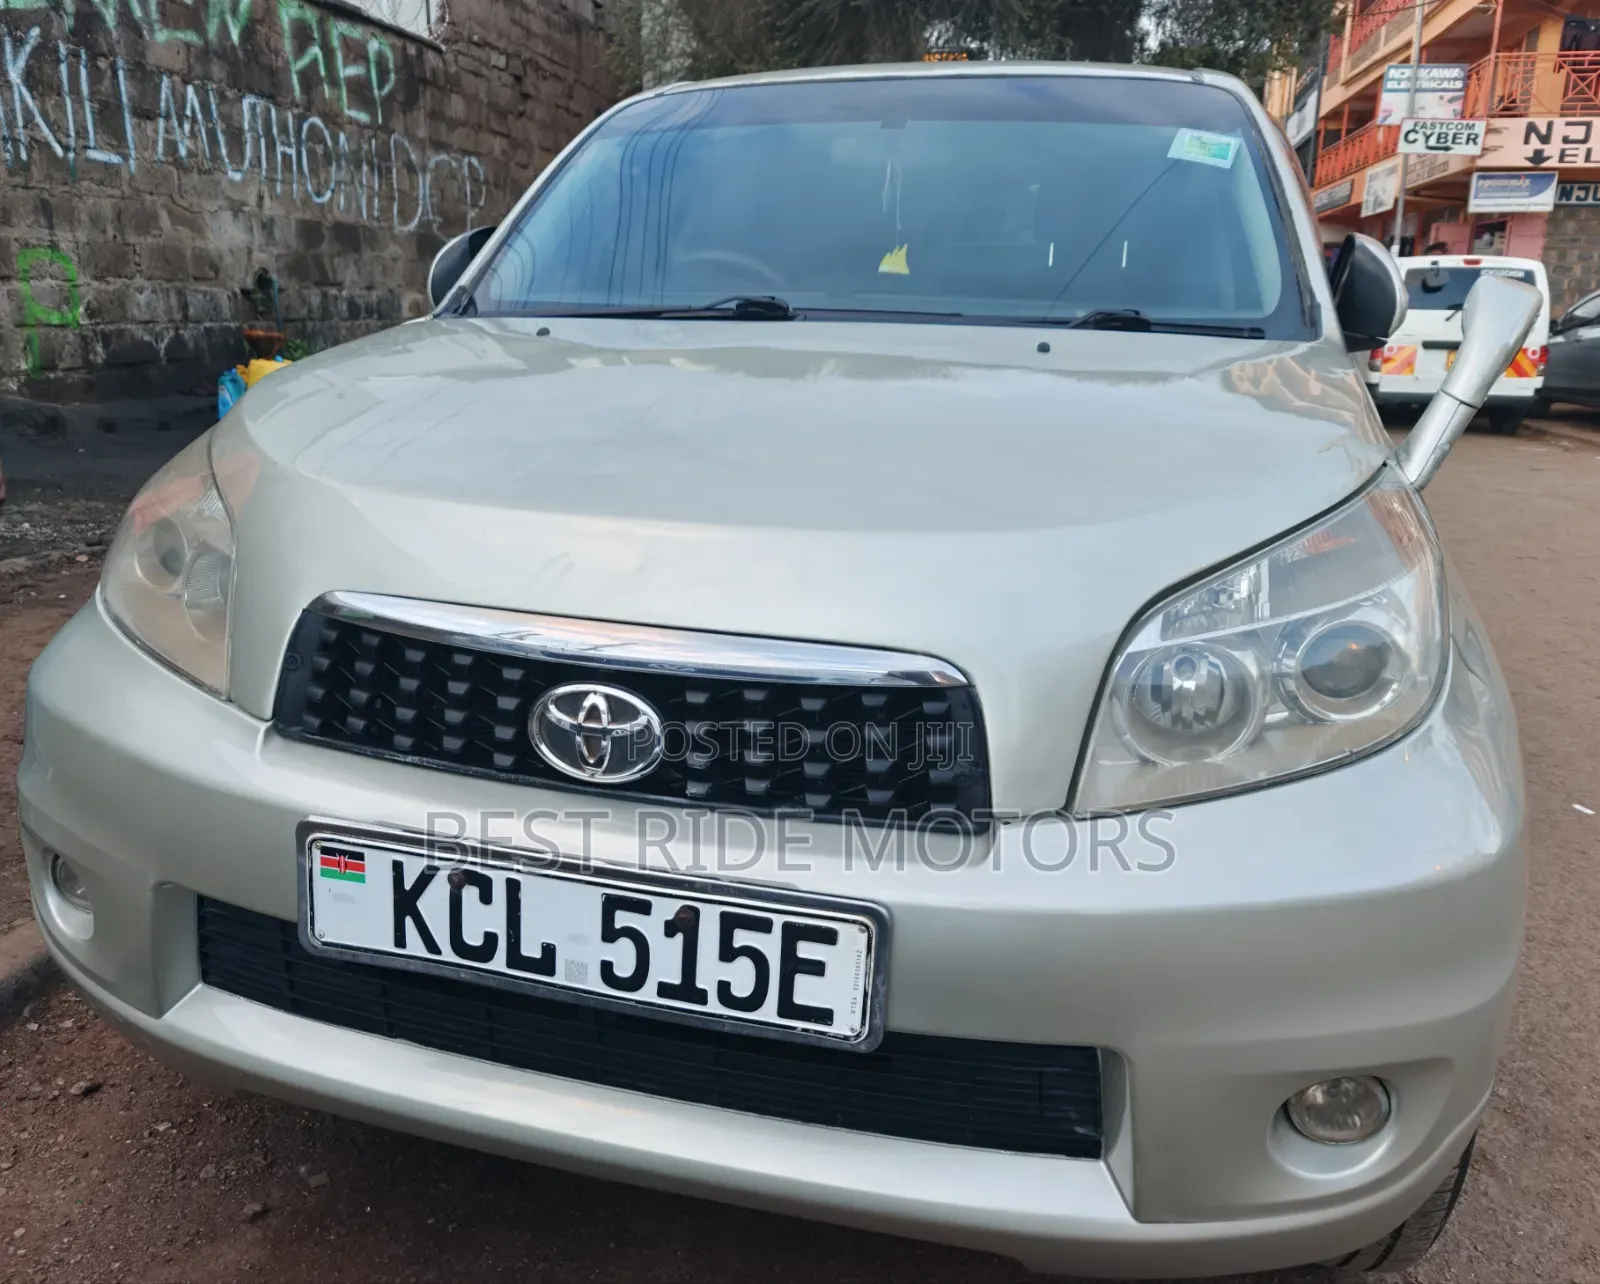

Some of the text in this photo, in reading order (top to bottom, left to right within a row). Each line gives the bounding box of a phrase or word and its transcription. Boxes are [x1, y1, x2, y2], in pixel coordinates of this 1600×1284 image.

[1413, 121, 1476, 131] FASTCOM
[1403, 129, 1479, 146] CYBER
[392, 859, 839, 1026] KCL 515E
